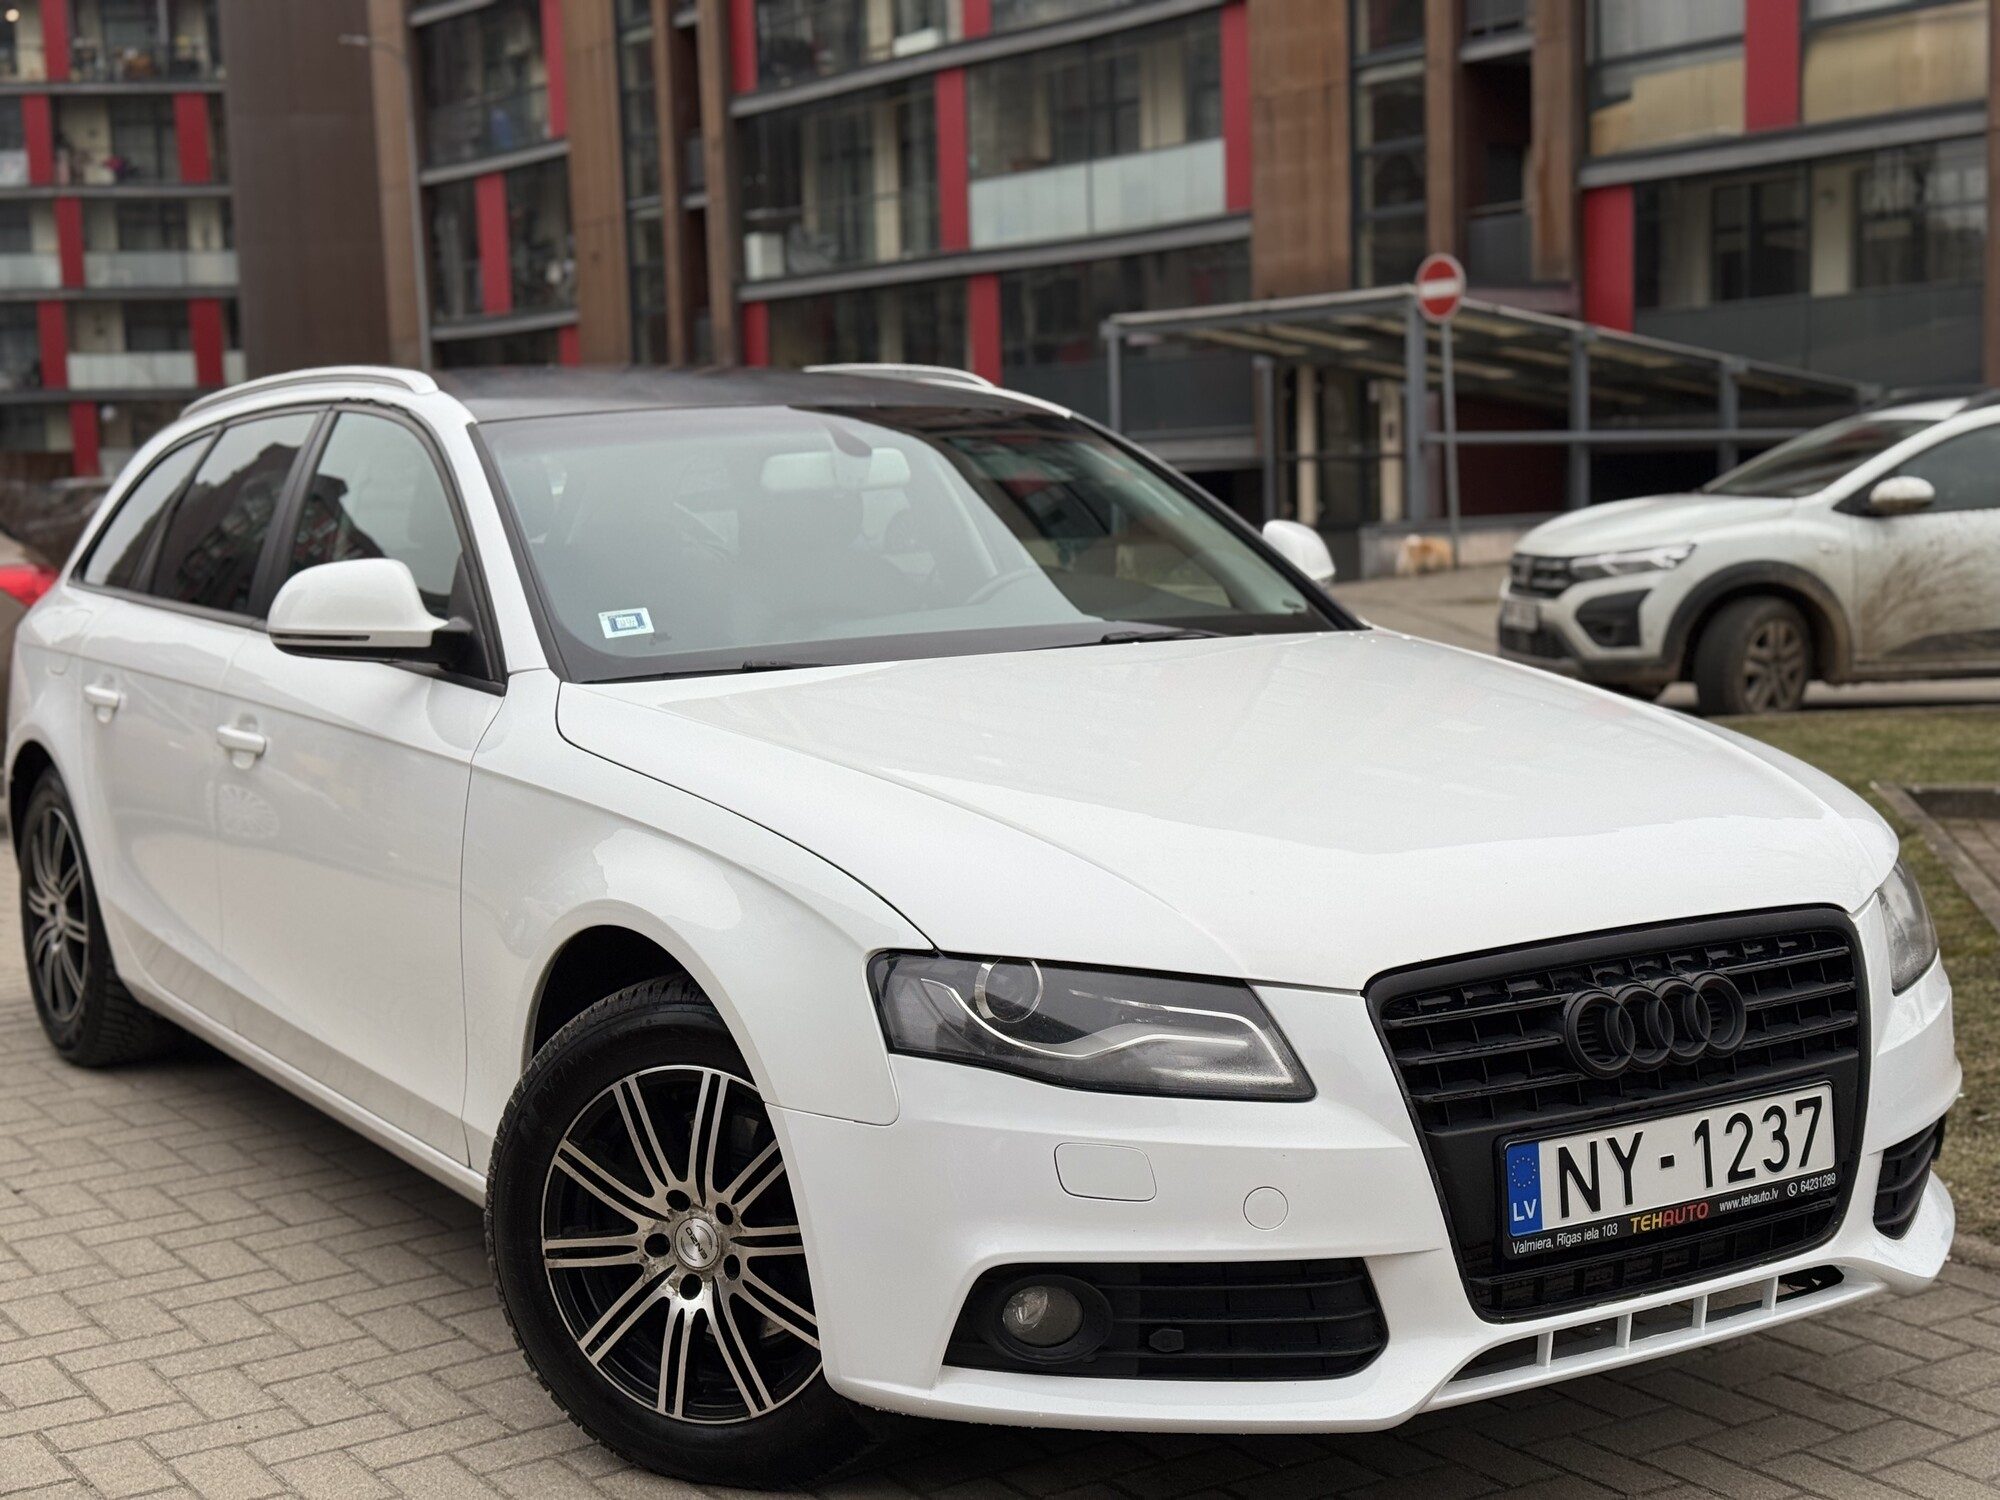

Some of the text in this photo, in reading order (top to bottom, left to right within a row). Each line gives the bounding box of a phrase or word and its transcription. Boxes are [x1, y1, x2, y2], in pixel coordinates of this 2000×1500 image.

[1800, 1173, 1837, 1194] 64231289
[1513, 1199, 1537, 1221] LV
[1719, 1188, 1779, 1212] www.tehauto.lv
[1631, 1202, 1709, 1234] TEHAUTO
[1512, 1223, 1618, 1254] Valmiera, Rīgas iela 103
